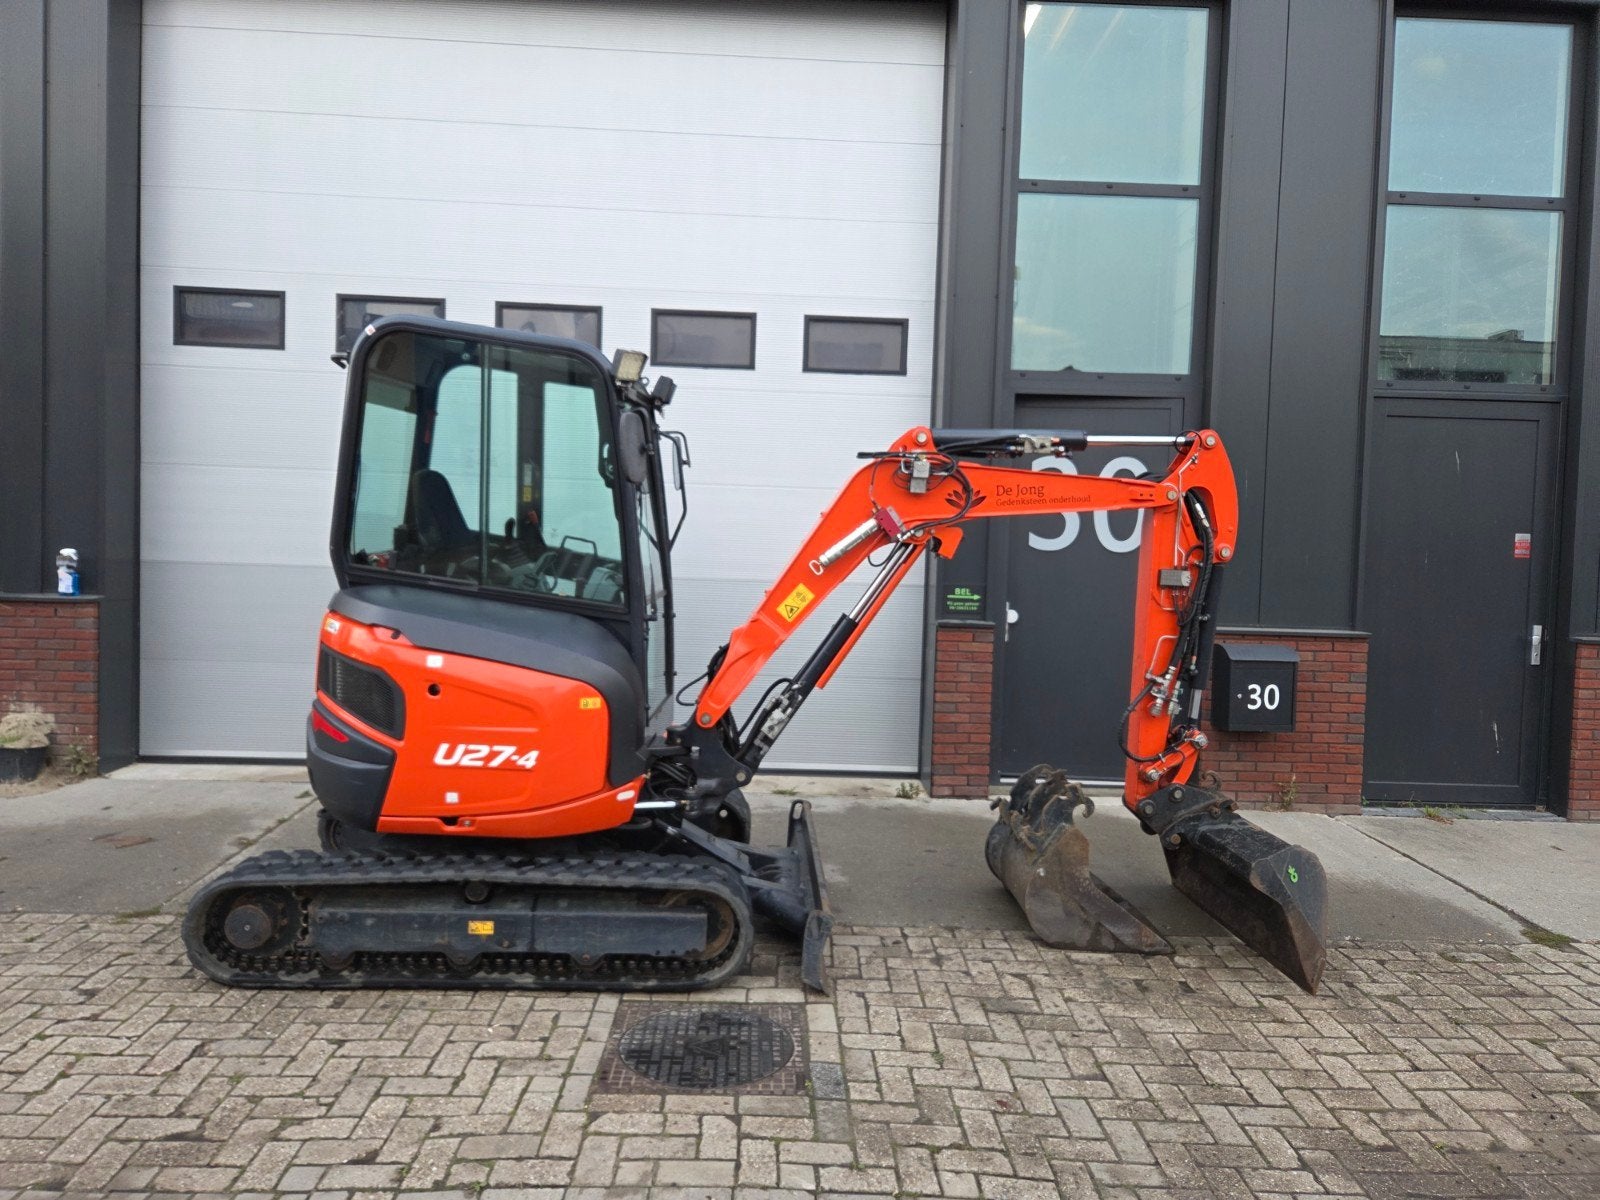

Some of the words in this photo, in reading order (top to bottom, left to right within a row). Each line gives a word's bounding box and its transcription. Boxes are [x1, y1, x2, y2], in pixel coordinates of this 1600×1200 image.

[996, 484, 1013, 497] De
[1016, 484, 1045, 497] Jong
[995, 497, 1047, 507] Gedenksteen
[1048, 495, 1091, 504] onderhoud
[1247, 683, 1280, 710] 30
[433, 743, 540, 769] U27-4
